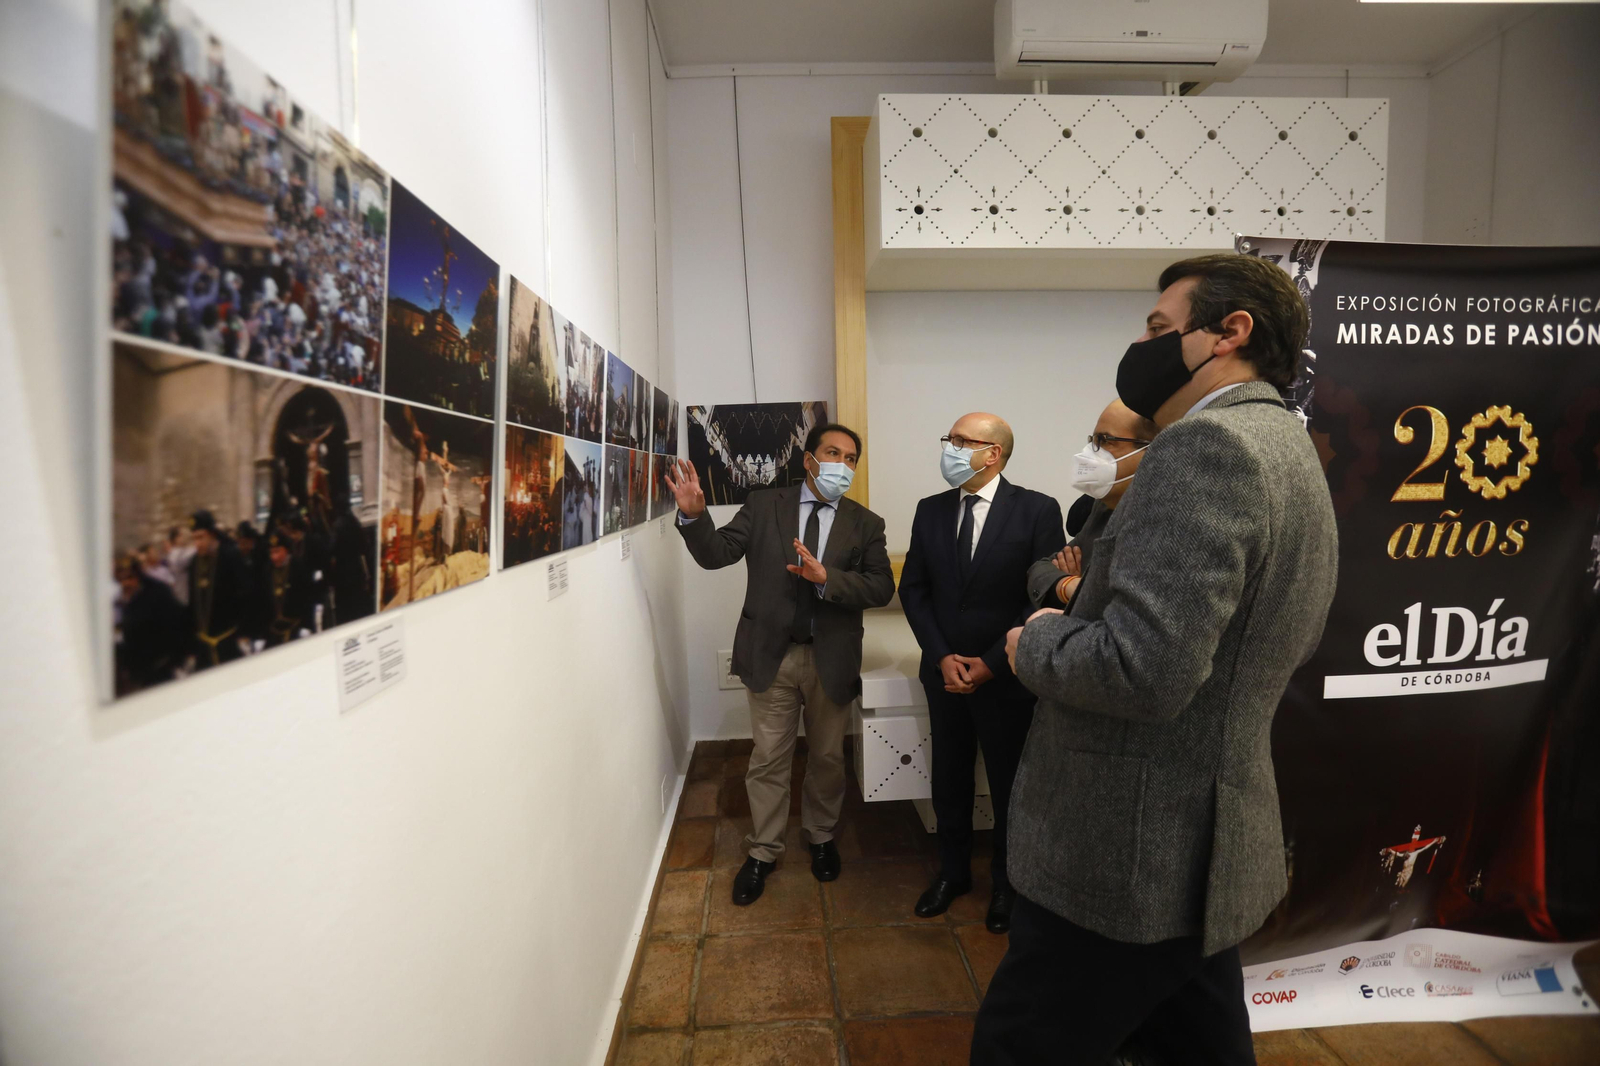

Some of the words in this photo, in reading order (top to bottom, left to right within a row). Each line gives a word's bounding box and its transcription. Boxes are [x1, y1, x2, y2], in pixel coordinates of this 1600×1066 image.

[1336, 294, 1456, 313] EXPOSICIÓN
[1336, 323, 1455, 346] MIRADAS
[1466, 324, 1497, 346] DE
[1507, 317, 1600, 346] PASIÓN
[1387, 508, 1530, 560] años
[1401, 676, 1418, 687] DE
[1424, 671, 1491, 686] CÓRDOBA
[1501, 970, 1532, 982] VIANA
[1252, 990, 1298, 1005] COVAP
[1376, 985, 1416, 999] Clece
